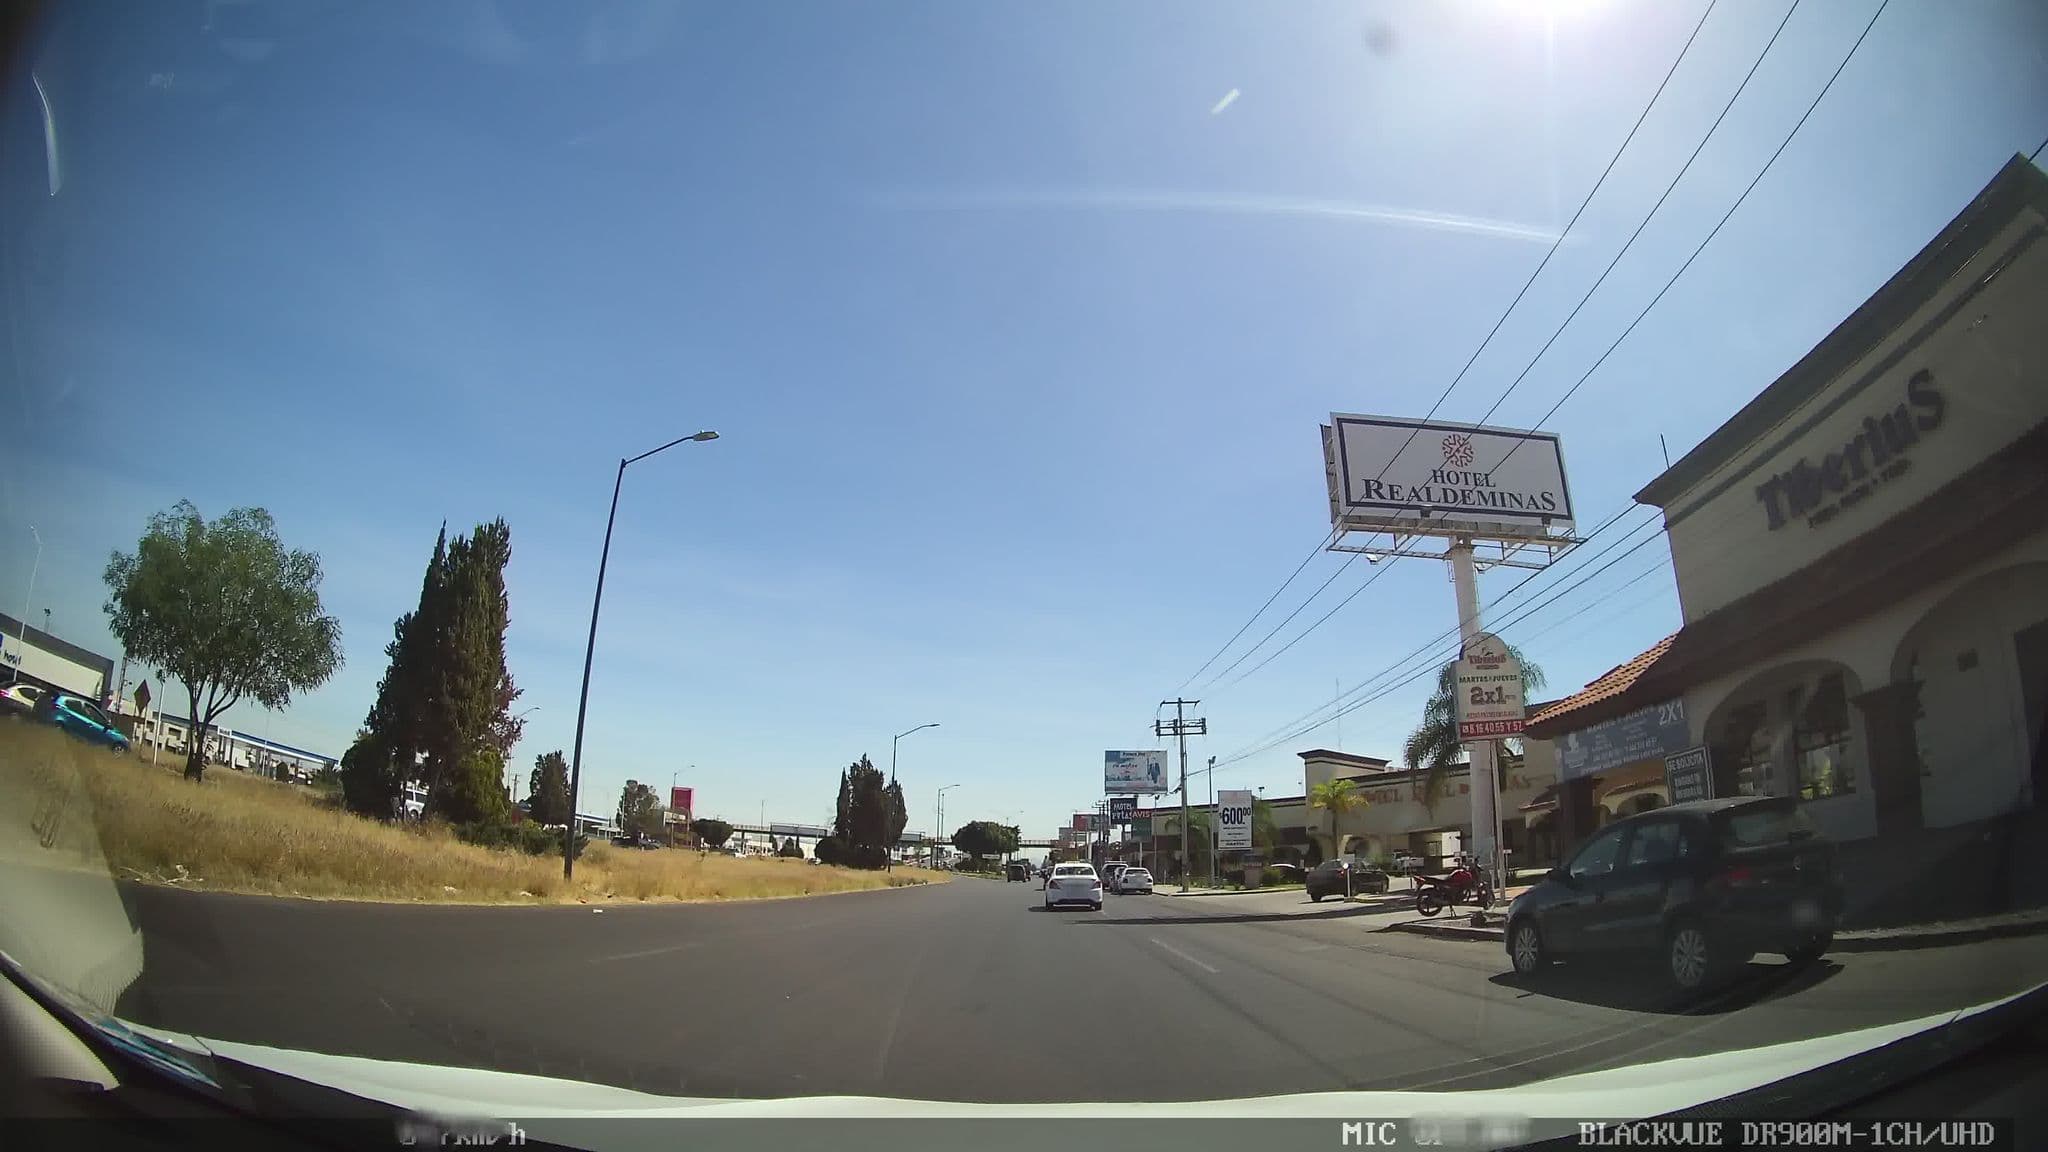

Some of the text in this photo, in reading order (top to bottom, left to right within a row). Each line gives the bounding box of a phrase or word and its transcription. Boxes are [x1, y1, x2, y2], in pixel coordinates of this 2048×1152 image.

[1432, 469, 1497, 488] HOTEL
[1658, 701, 1684, 727] 2X1
[1132, 810, 1150, 818] AVIS
